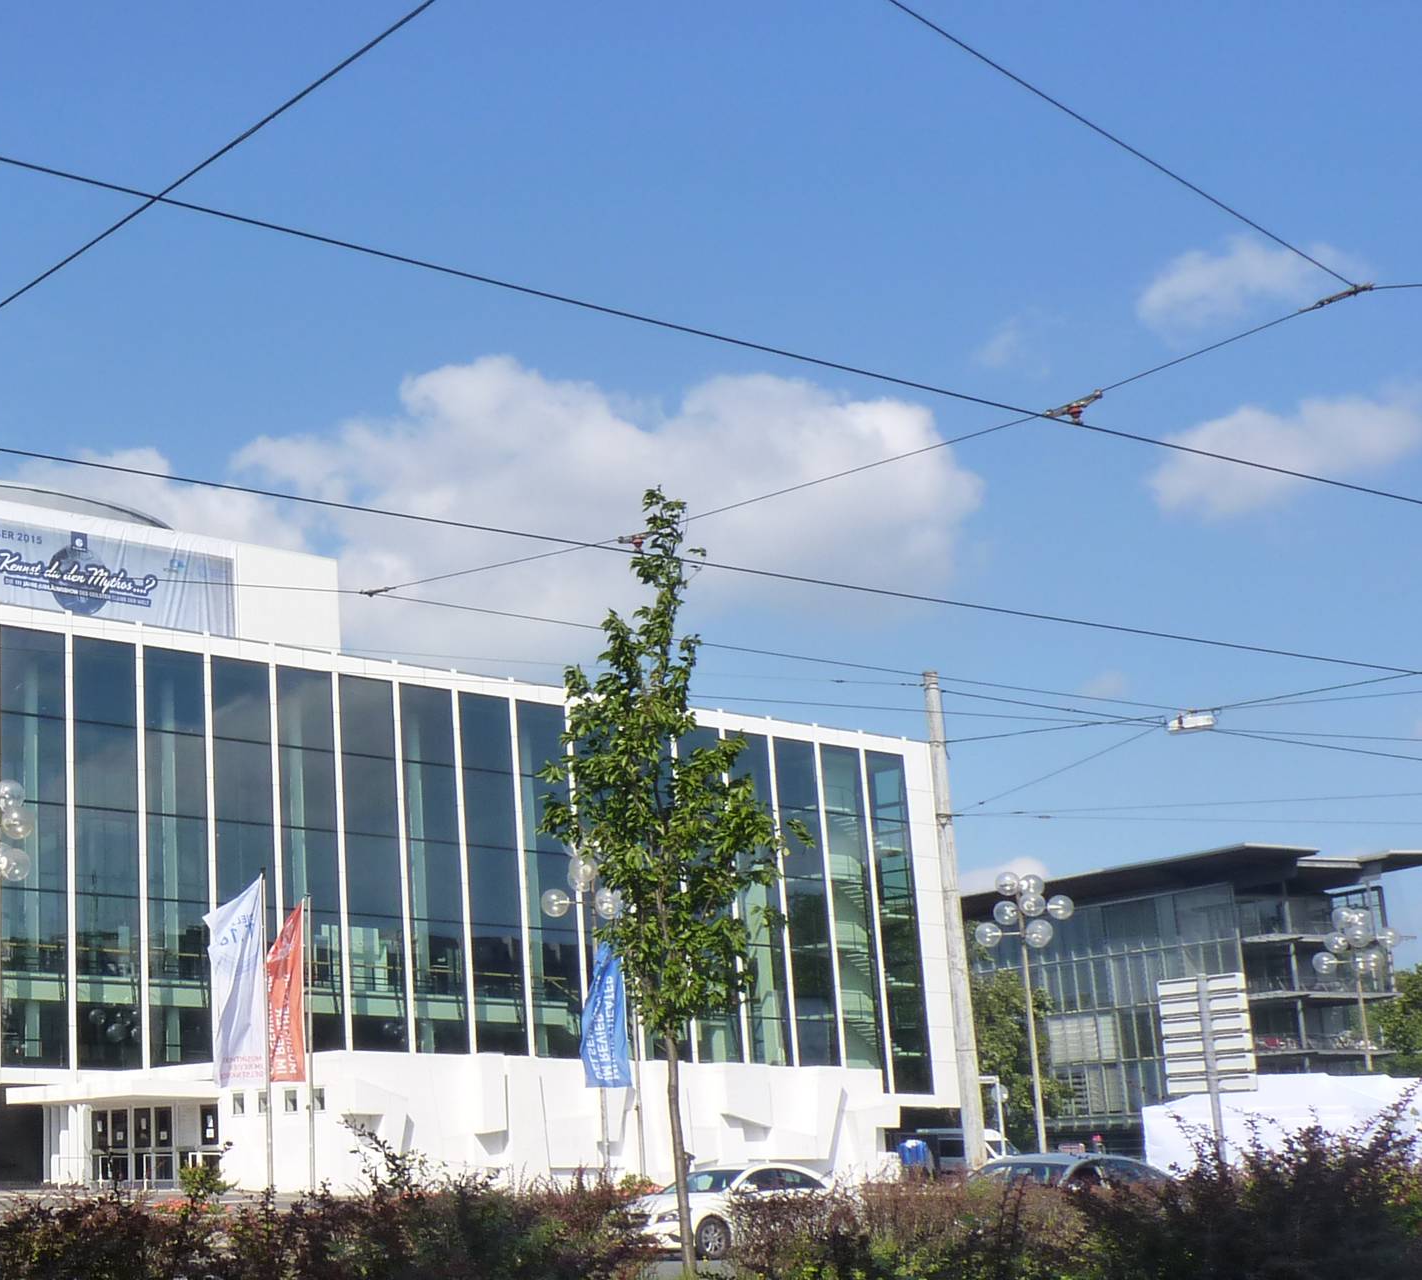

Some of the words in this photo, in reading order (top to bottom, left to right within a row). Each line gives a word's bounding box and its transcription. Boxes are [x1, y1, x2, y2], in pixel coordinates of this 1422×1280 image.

[17, 532, 42, 544] 2015
[0, 553, 41, 576] Kennst
[44, 561, 60, 579] du
[63, 564, 85, 582] den
